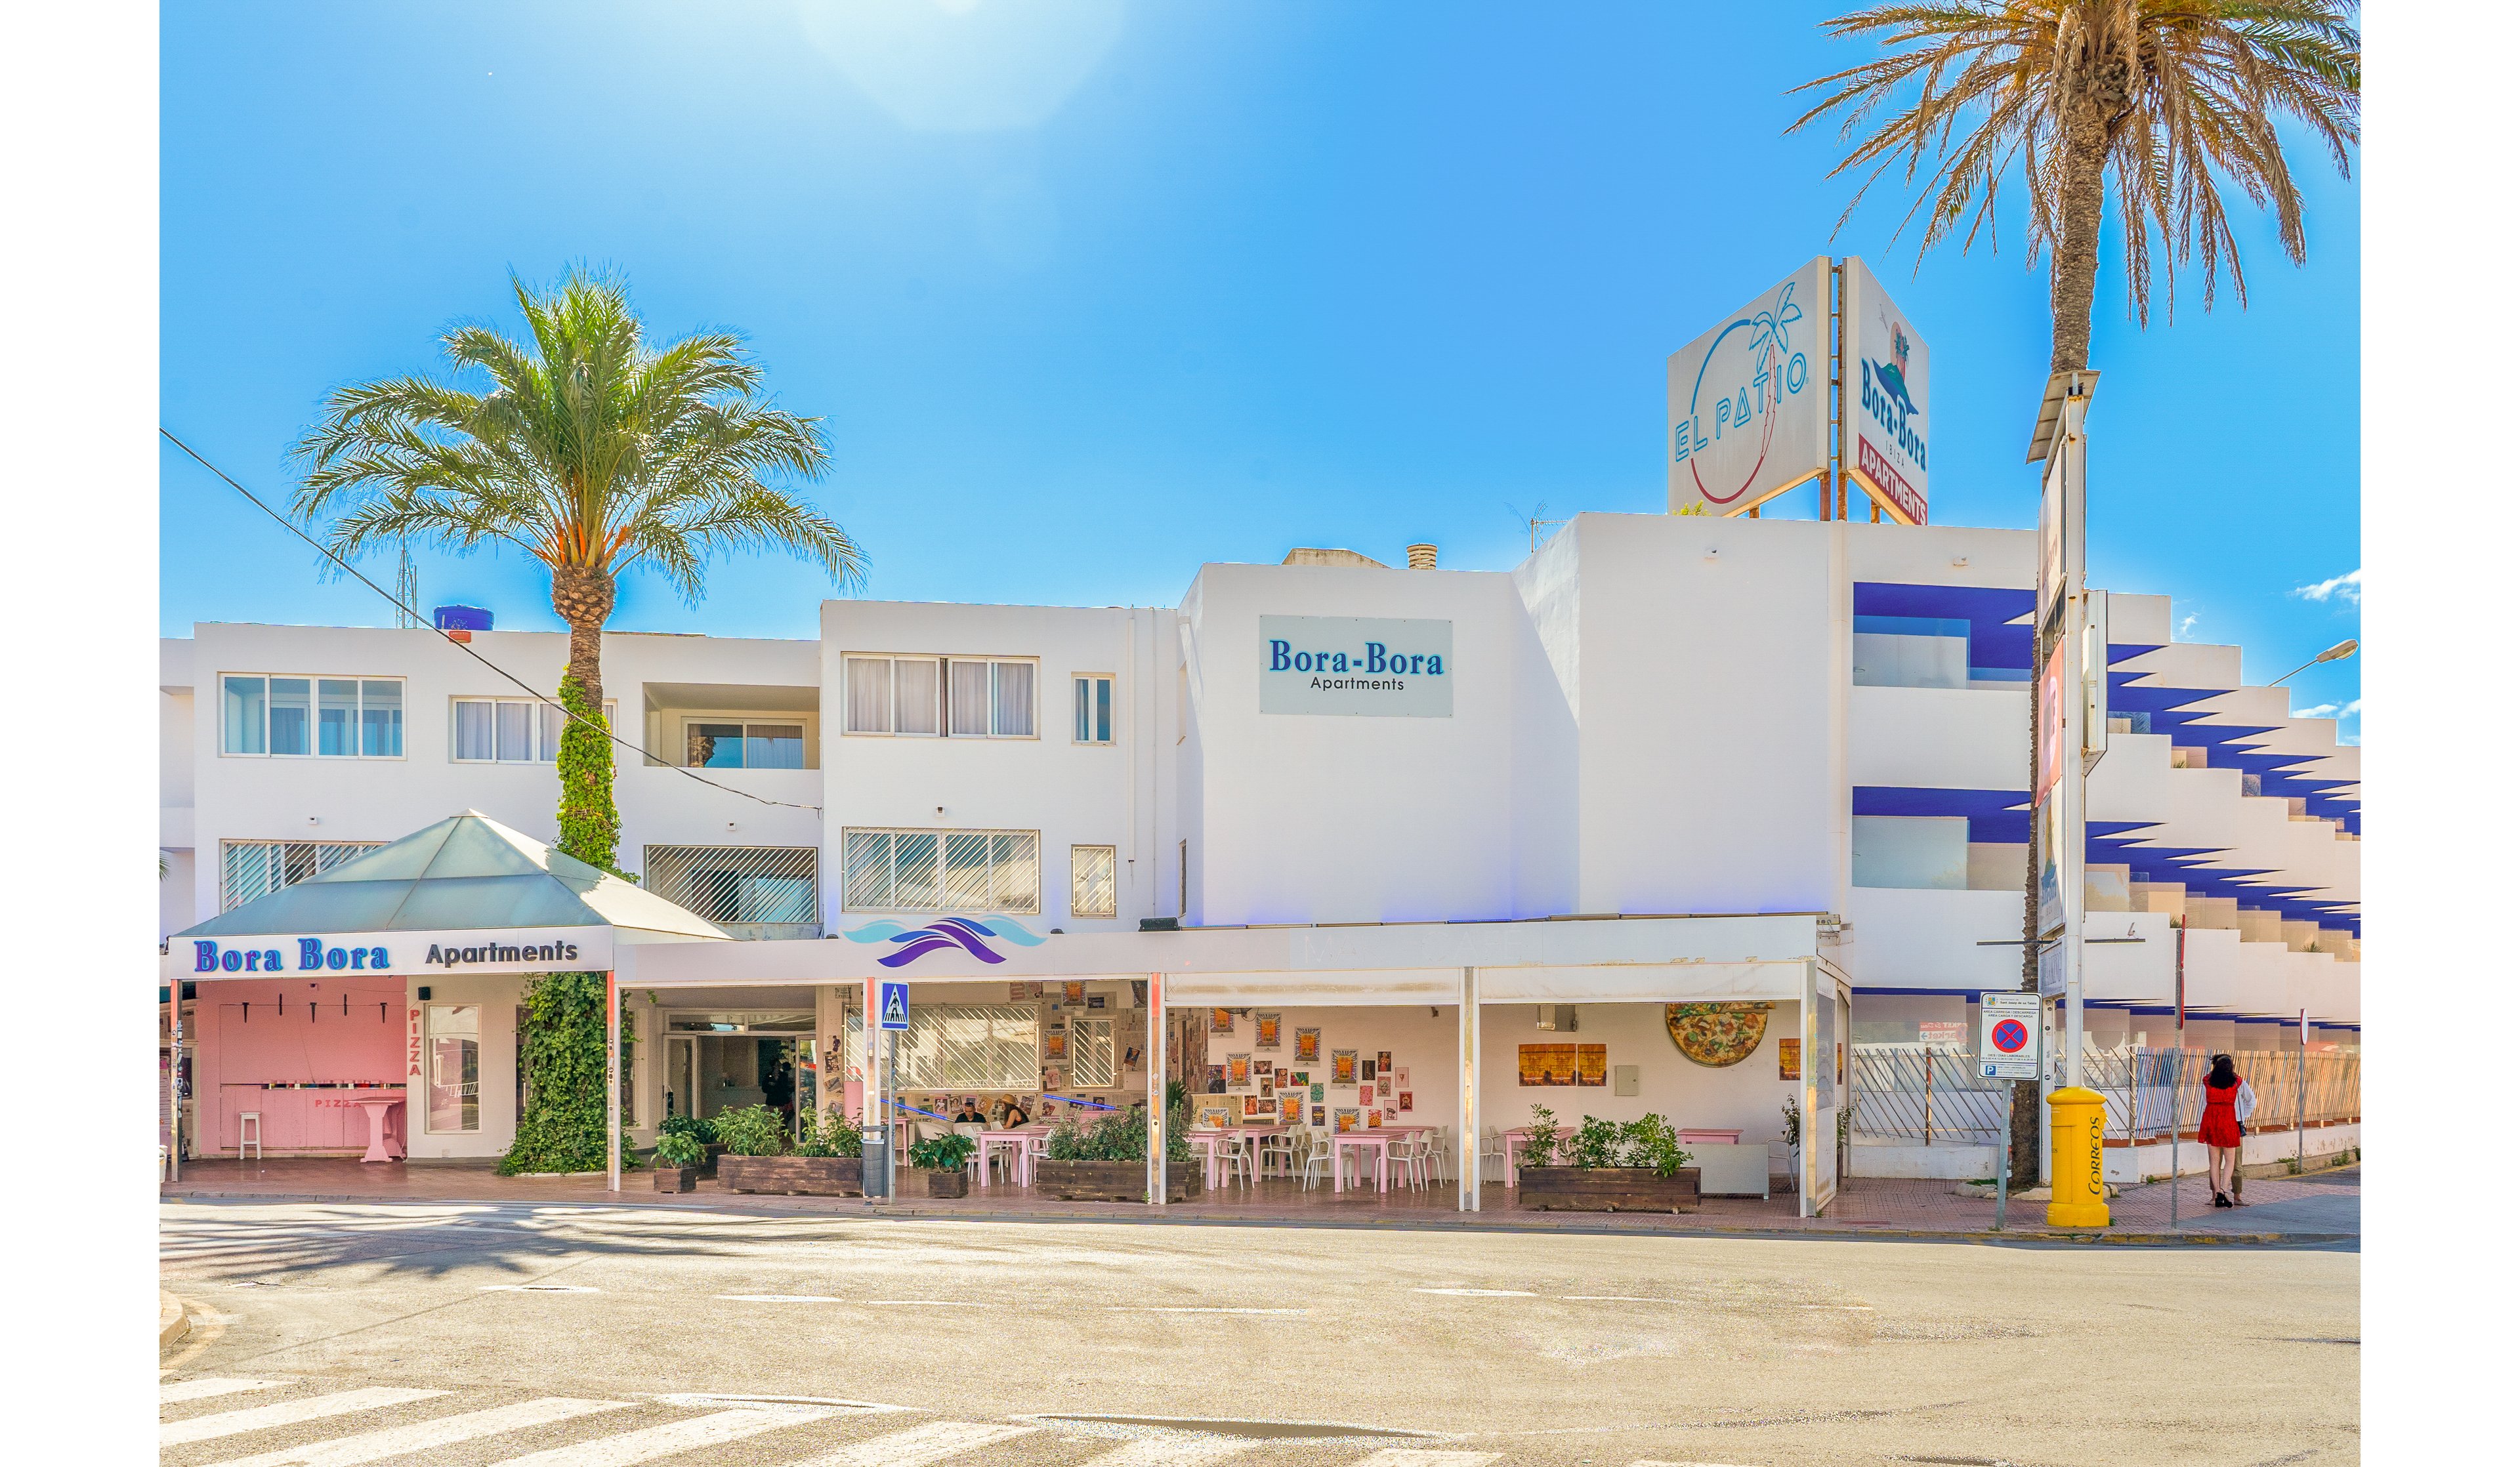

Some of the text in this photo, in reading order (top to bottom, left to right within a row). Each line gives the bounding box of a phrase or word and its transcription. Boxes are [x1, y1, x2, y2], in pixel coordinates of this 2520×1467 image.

[1675, 352, 1807, 462] EL PATIO
[1862, 358, 1926, 473] Bora-Bora
[1861, 443, 1926, 526] APARTMENTS
[1886, 440, 1904, 468] IBIZA
[1269, 639, 1444, 675] Bora-Bora
[1311, 676, 1404, 691] Apartments
[194, 938, 578, 972] Bora Bora Apartments
[409, 1010, 421, 1075] PIZZA
[2088, 1117, 2101, 1195] CORREOS
